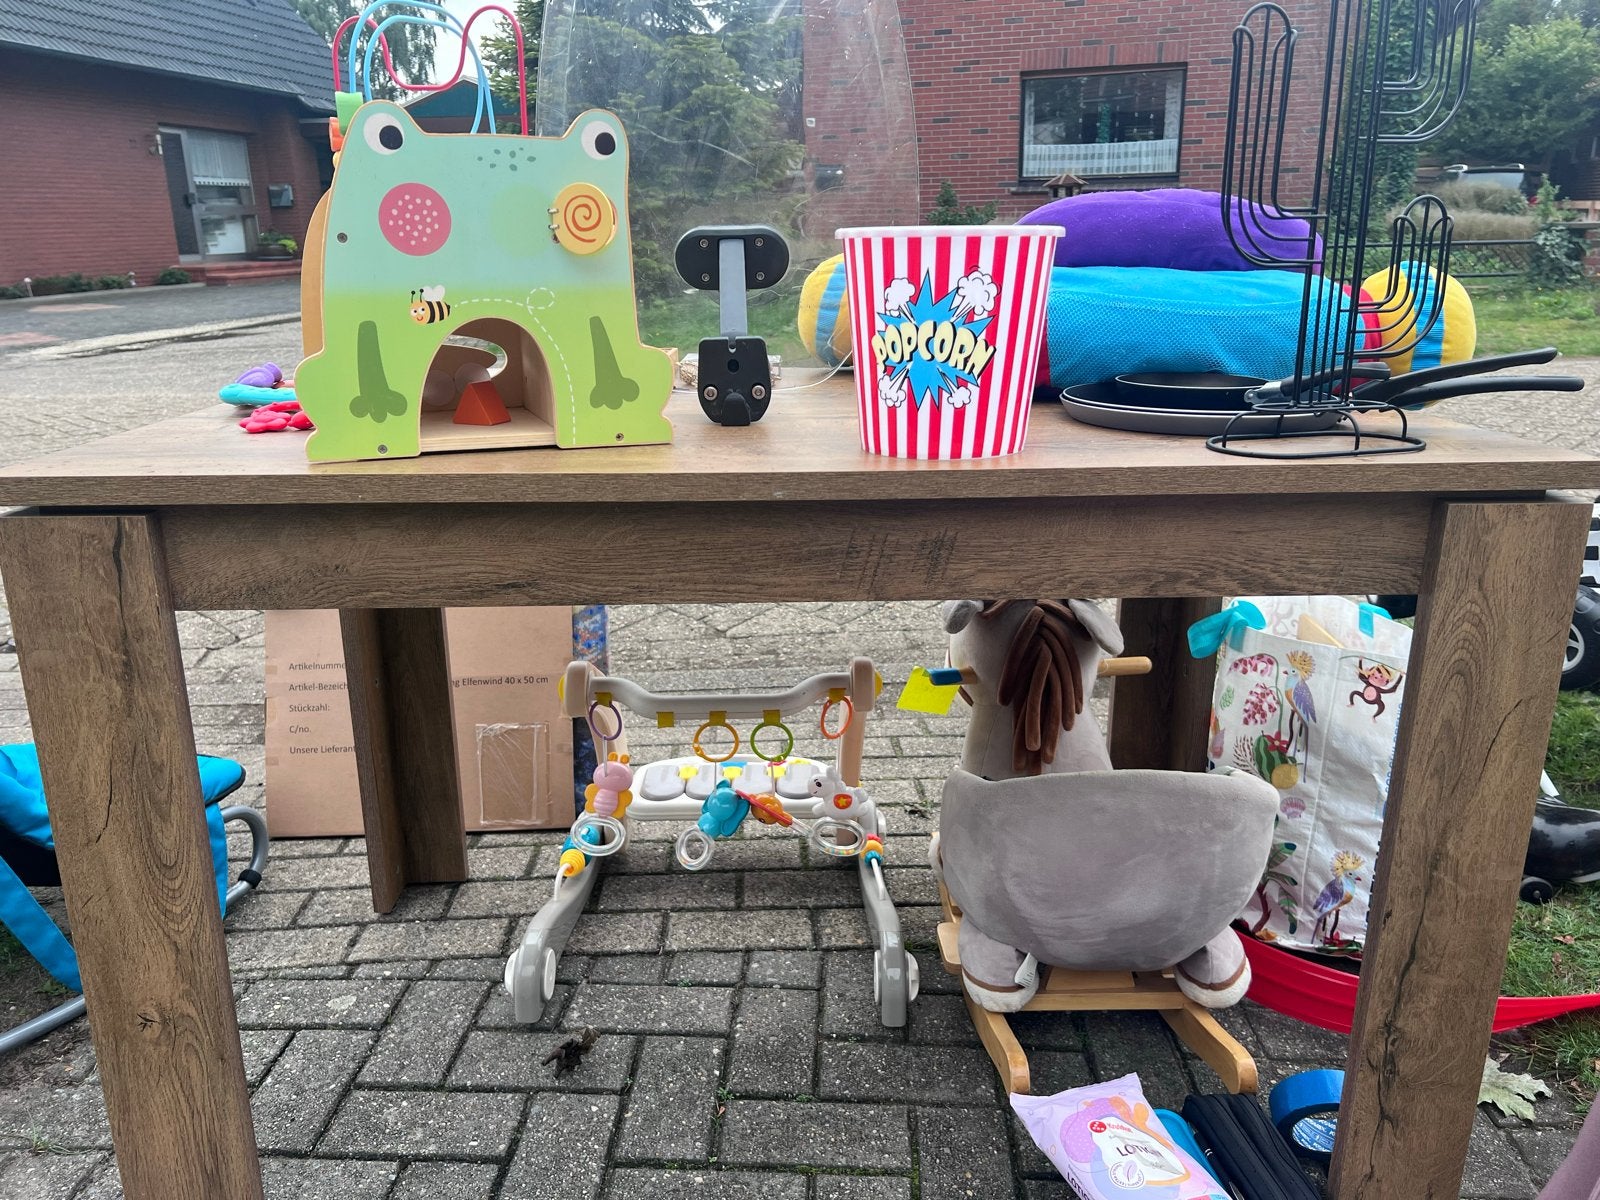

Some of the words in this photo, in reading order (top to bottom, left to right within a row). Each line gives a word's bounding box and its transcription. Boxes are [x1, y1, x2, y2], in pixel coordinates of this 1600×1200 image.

[872, 320, 996, 380] POPCORN
[462, 677, 502, 686] Elfenwind
[504, 677, 516, 685] 40
[523, 676, 535, 684] 50
[289, 703, 330, 713] Stückzahl:
[289, 725, 312, 734] C/no.
[289, 746, 319, 754] Unsere
